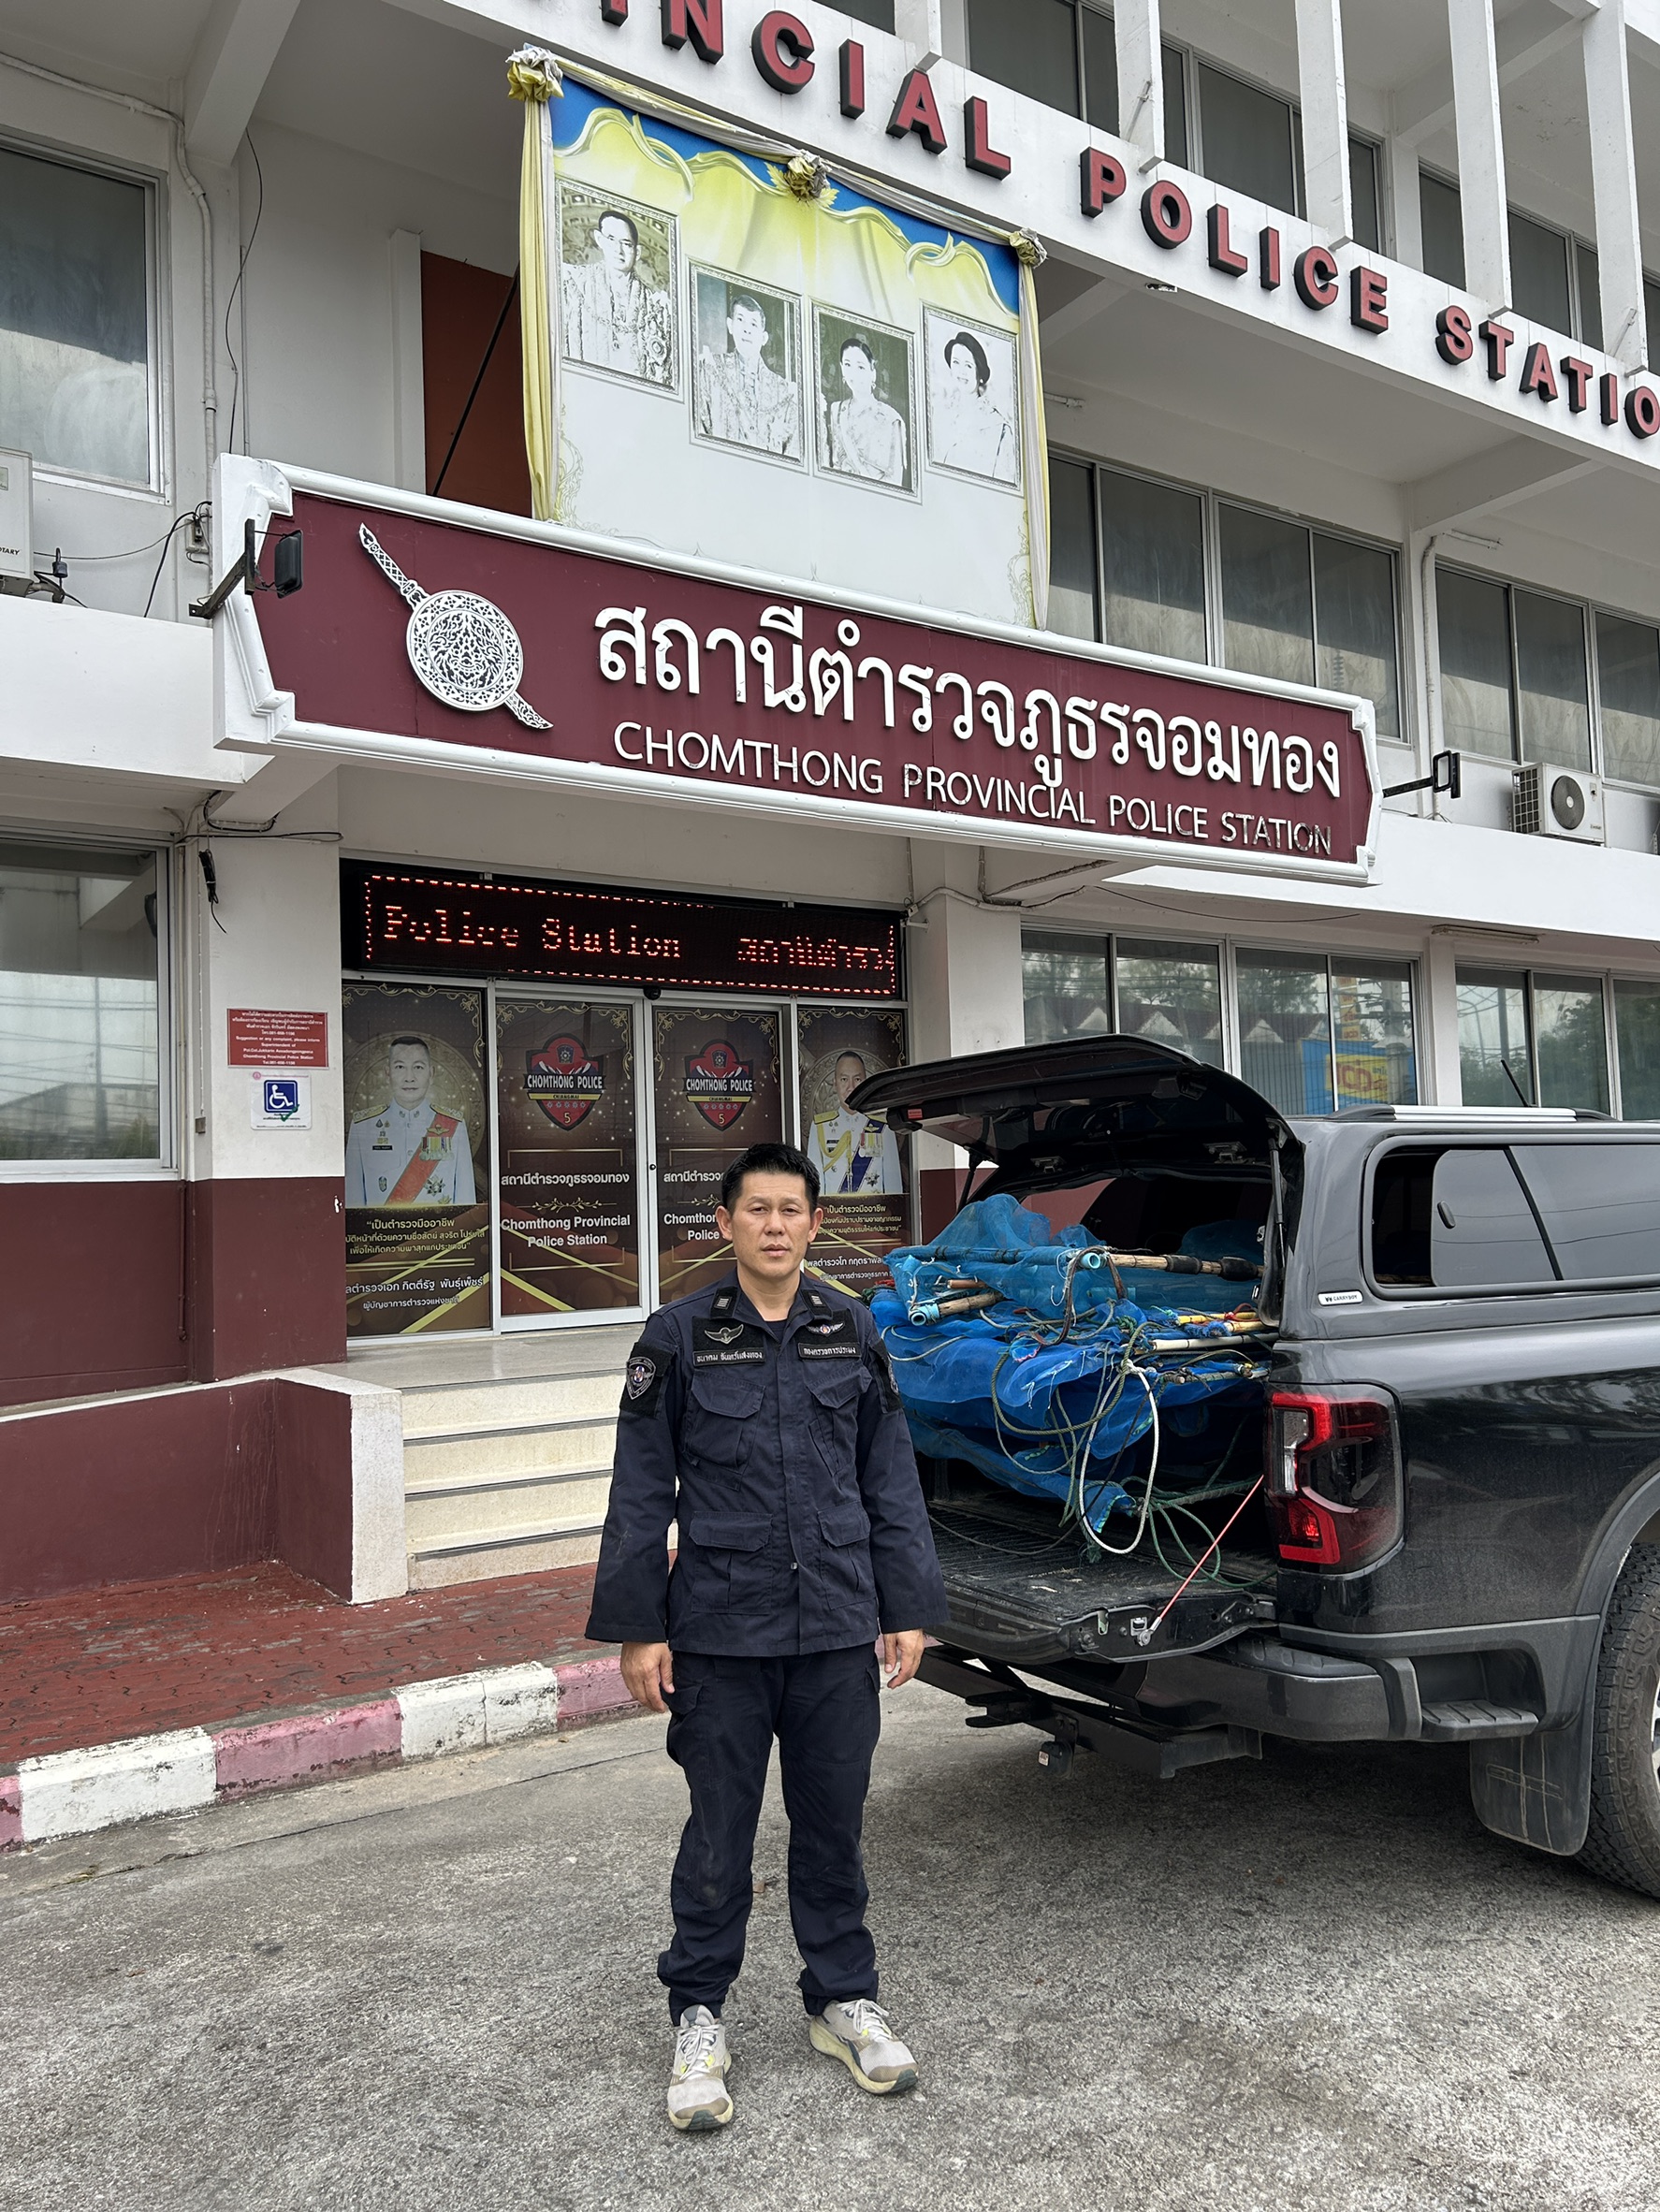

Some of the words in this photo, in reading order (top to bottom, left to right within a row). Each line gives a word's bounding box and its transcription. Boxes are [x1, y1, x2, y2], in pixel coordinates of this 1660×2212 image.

[601, 0, 1012, 182] NCIAL
[1080, 146, 1390, 335] POLICE
[1435, 304, 1660, 440] STATIO
[594, 604, 1342, 799] สถานีตำรวจภูธรจอมทอง
[614, 720, 883, 794] CHOMTHONG
[903, 763, 1097, 825] PROVINCIAL
[1109, 794, 1209, 839] POLICE
[1220, 811, 1332, 855] STATION
[384, 906, 519, 947] Police
[542, 918, 682, 958] Station
[527, 1074, 574, 1088] CHOMTHONG
[577, 1075, 603, 1089] POLICE
[686, 1078, 728, 1091] CHOMTHONG
[730, 1079, 753, 1092] POLICE
[564, 1112, 571, 1124] 5
[719, 1113, 725, 1125] 5
[501, 1171, 630, 1187] สถานีตำรวจภูธรจอมทอง
[501, 1217, 571, 1230] Chomthong
[574, 1215, 631, 1228] Provincial
[528, 1234, 564, 1248] Police
[567, 1233, 607, 1246] Station
[688, 1229, 720, 1241] Police
